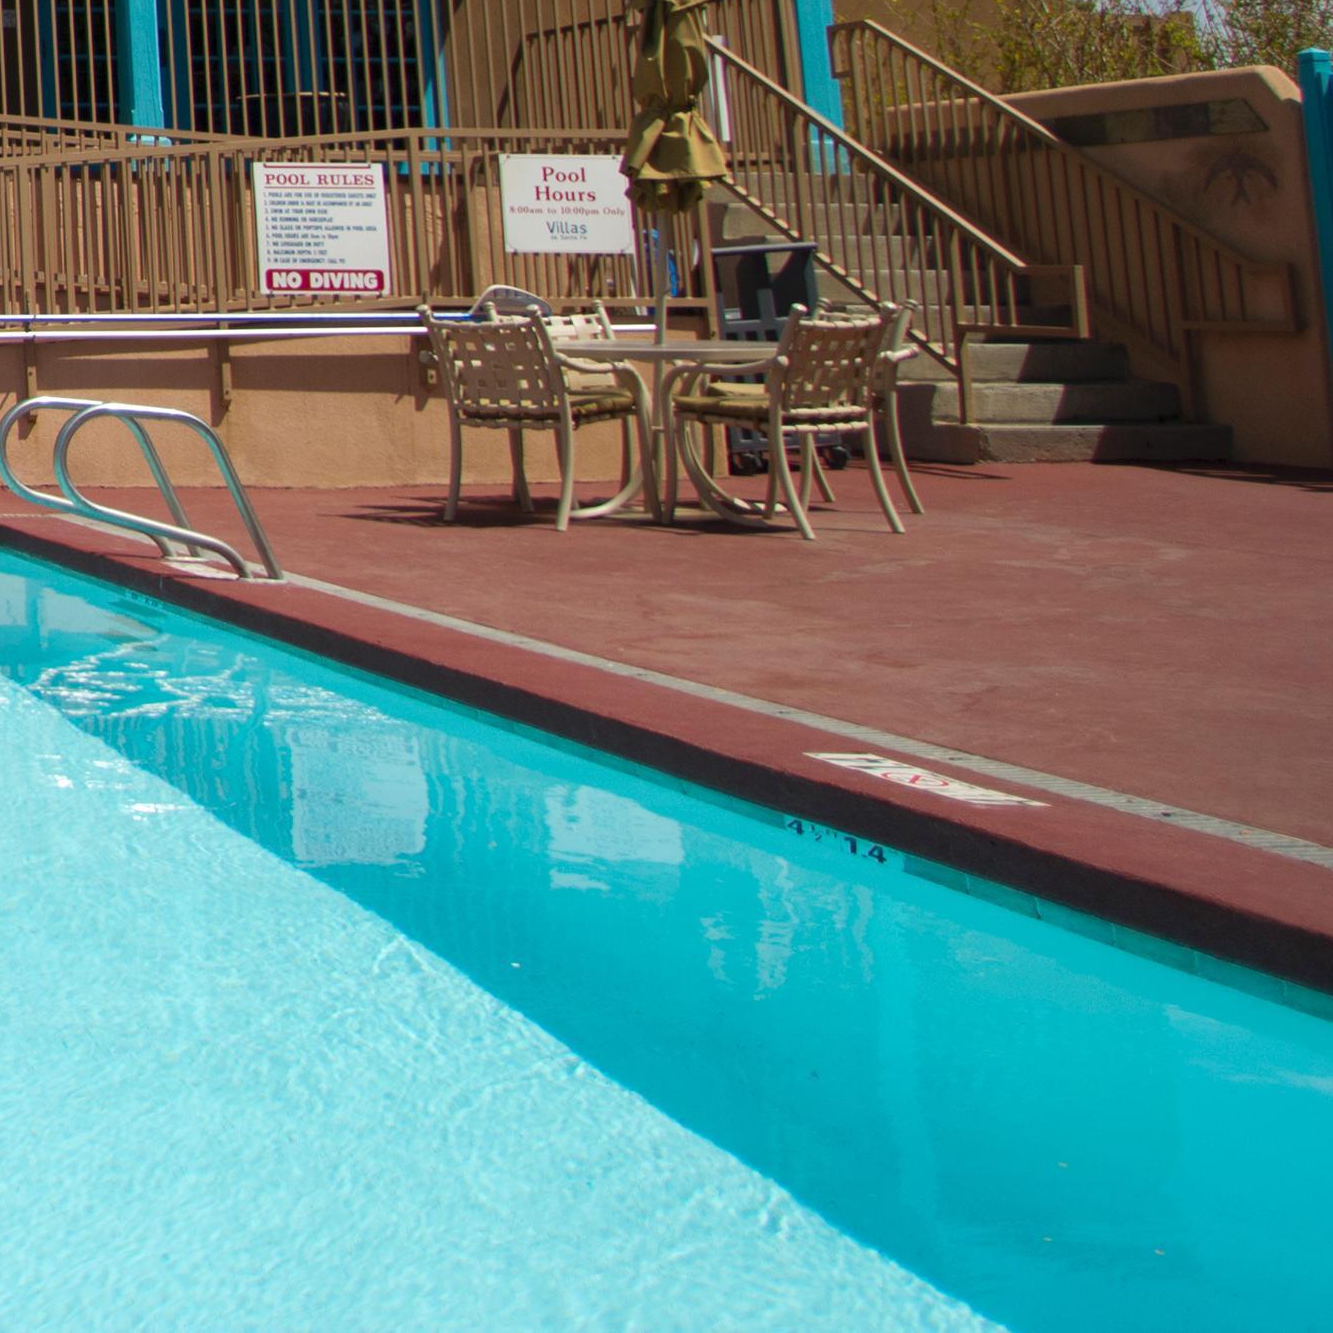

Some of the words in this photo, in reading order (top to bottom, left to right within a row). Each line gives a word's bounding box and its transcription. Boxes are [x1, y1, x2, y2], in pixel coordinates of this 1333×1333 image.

[265, 174, 309, 185] POOL
[317, 174, 374, 185] RULES
[542, 166, 585, 182] Pool
[535, 186, 596, 201] Hours
[603, 207, 625, 216] Only
[547, 221, 587, 234] Villas
[272, 272, 302, 289] NO
[310, 272, 378, 289] DIVING
